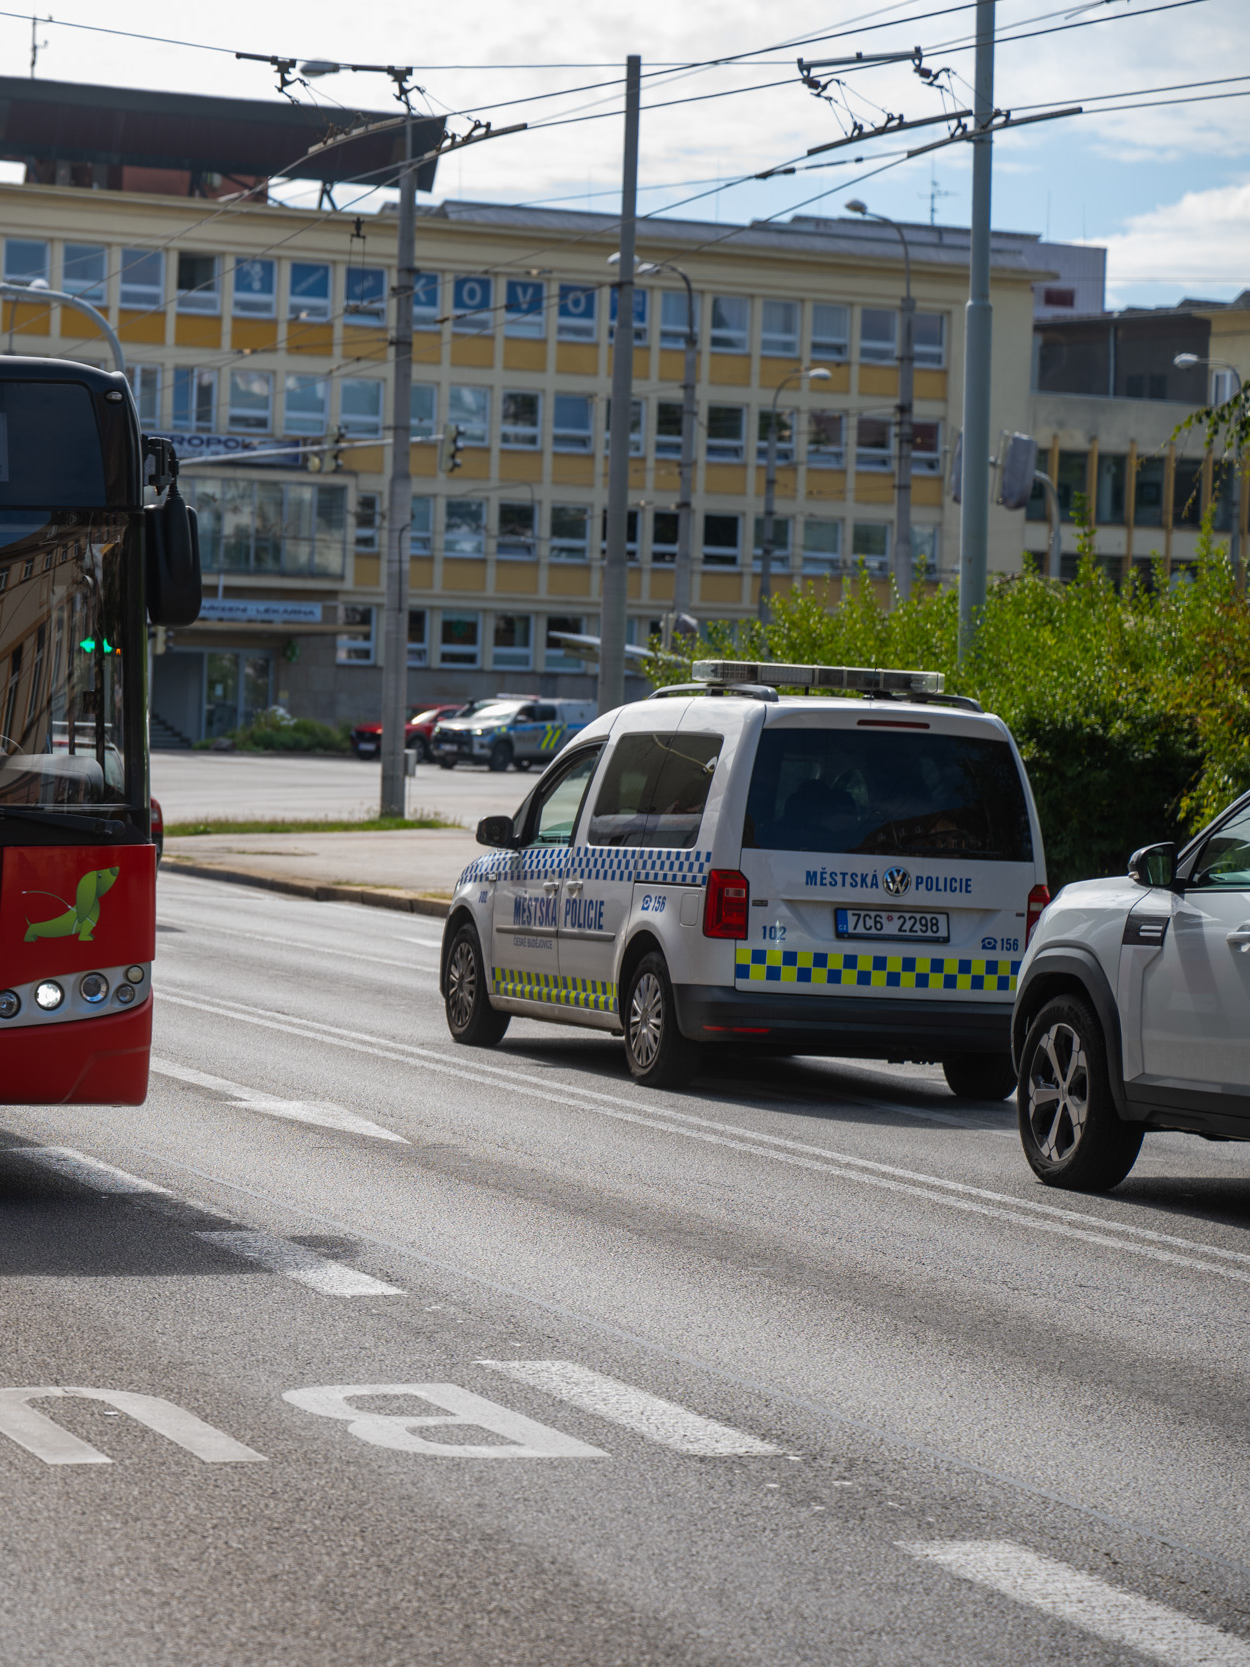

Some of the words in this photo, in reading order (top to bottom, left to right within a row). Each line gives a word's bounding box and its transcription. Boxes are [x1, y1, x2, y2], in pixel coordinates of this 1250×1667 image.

[805, 866, 879, 889] MĚSTSKÁ
[915, 875, 973, 894] POLICIE
[513, 889, 558, 927] MĚSTSKÁ
[564, 897, 605, 930] POLICIE
[651, 895, 667, 913] 156
[761, 924, 787, 942] 102
[851, 912, 884, 932] 7C6
[897, 914, 940, 934] 2298
[1001, 937, 1019, 952] 156
